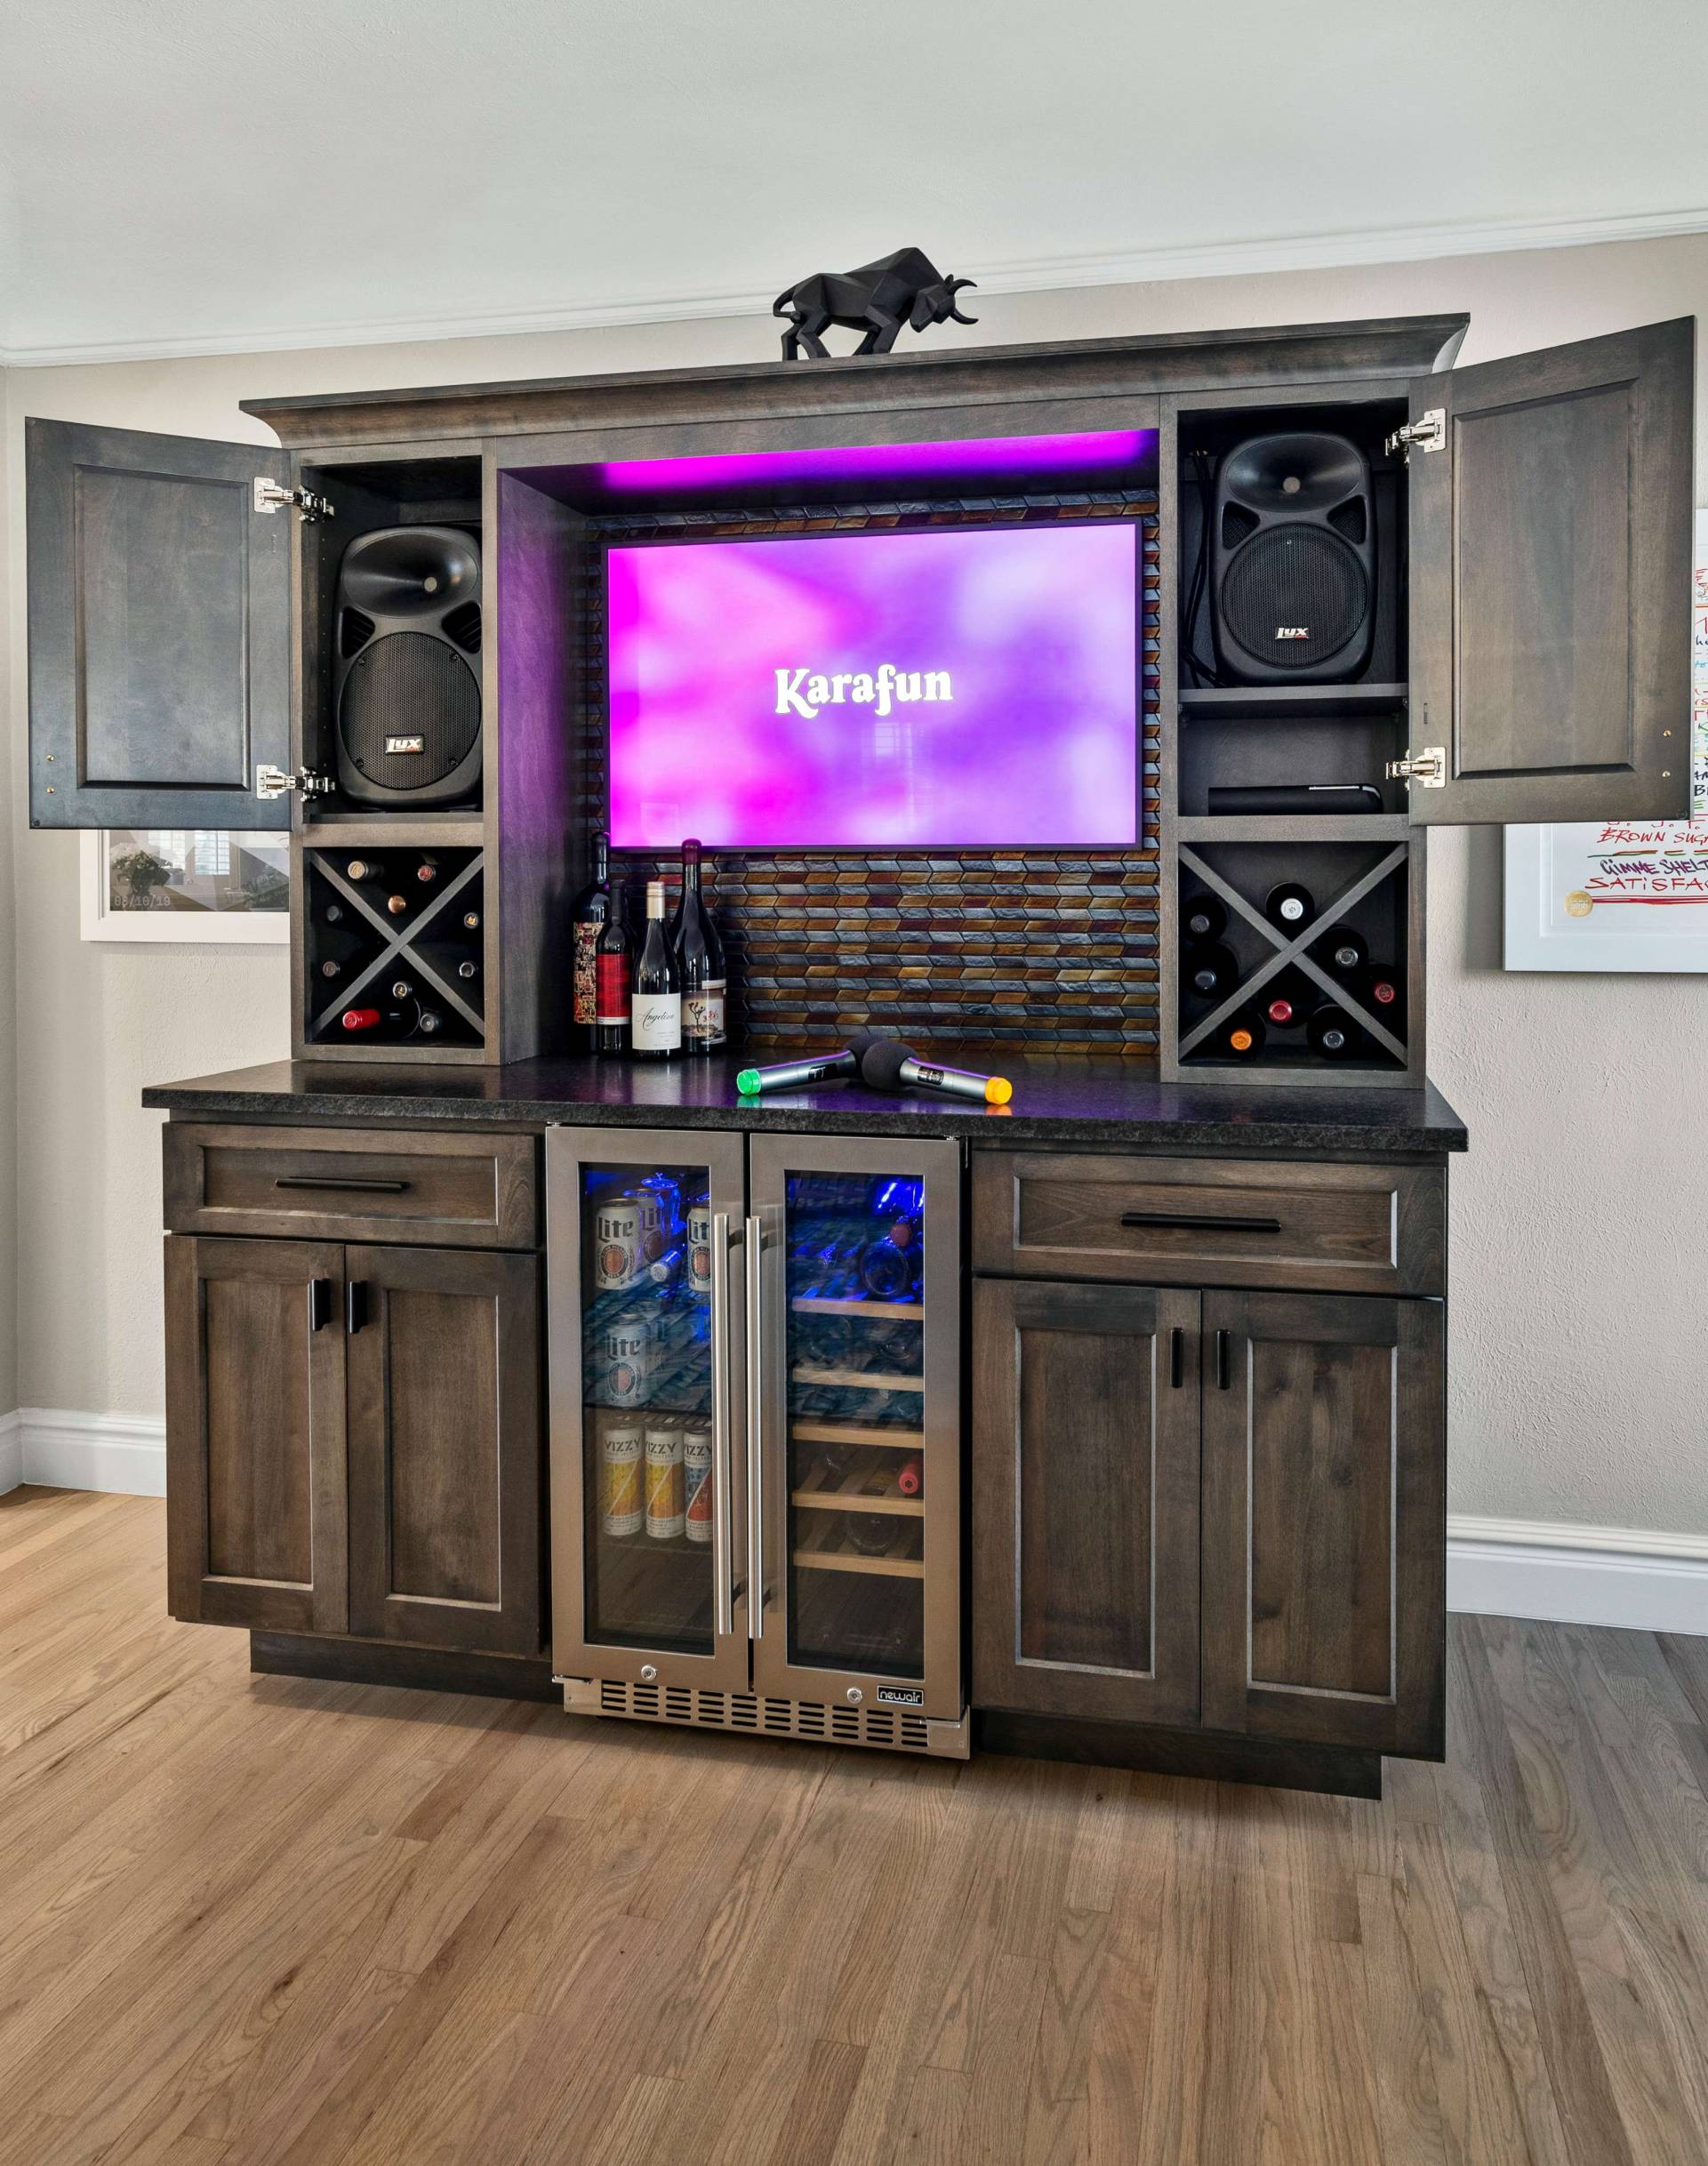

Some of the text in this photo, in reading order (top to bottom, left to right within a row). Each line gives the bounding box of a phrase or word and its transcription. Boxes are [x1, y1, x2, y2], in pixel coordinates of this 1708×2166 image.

[775, 663, 953, 719] Karafun
[1597, 826, 1666, 845] BROWN
[1584, 877, 1708, 892] SATiSFA
[597, 1216, 633, 1243] Lite
[607, 1335, 640, 1360] Lite
[605, 1437, 641, 1452] VIZZY
[879, 1691, 921, 1703] newair
